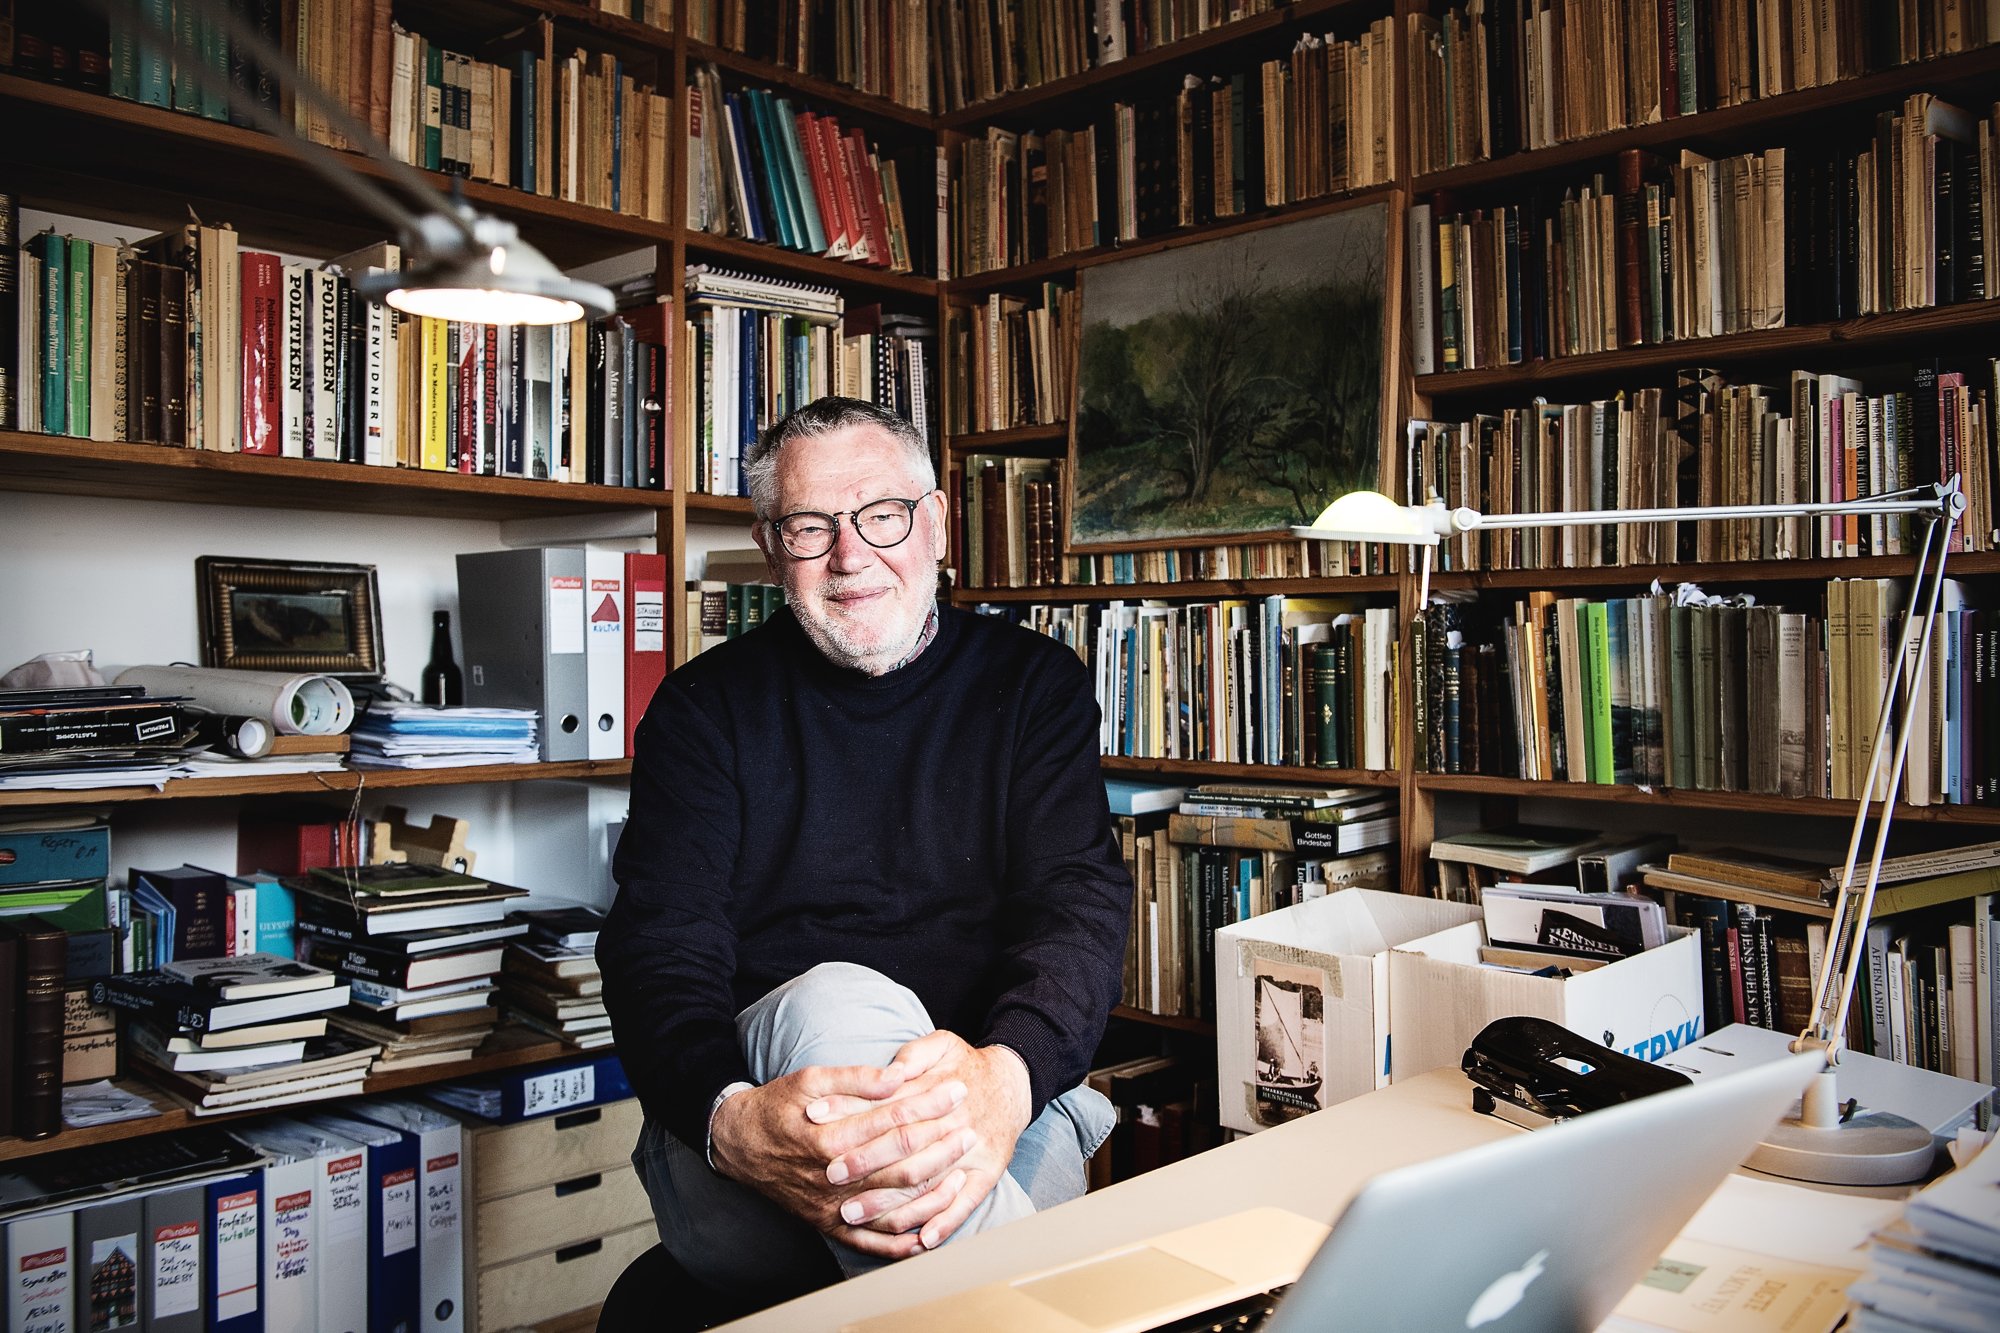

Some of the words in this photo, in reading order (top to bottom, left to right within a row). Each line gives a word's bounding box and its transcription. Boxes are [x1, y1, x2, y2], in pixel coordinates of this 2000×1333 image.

[290, 273, 302, 394] POLITIKEN
[323, 277, 336, 395] POLITIKEN
[431, 379, 439, 409] Modern
[462, 406, 470, 437] OUTSIDER
[1857, 401, 1866, 426] HANS
[1872, 403, 1882, 424] HANS
[1887, 399, 1895, 421] HANS
[1898, 397, 1908, 426] HANS
[430, 411, 438, 442] Century
[1857, 427, 1866, 448] KIRK
[1872, 425, 1882, 443] KIRK
[1887, 422, 1895, 442] KIRK
[1800, 438, 1808, 462] HANS
[1898, 427, 1908, 452] KIRK
[1800, 463, 1808, 482] KIRK
[1415, 634, 1423, 665] Heinrich
[1976, 633, 1984, 683] Fredericiabogen
[1989, 630, 1997, 678] Fredericiabogen
[56, 731, 97, 741] PLASTLOMME
[141, 722, 170, 735] PREMIUM
[1989, 777, 1997, 793] 2016
[1297, 838, 1332, 848] Bindesbøll
[1304, 831, 1332, 841] Gottlieb
[1221, 865, 1230, 896] Maleren
[1549, 926, 1620, 954] HENNER
[1740, 933, 1754, 964] JENS
[1743, 966, 1758, 1004] JUELS
[1872, 946, 1885, 1027] AFTENLANDET
[1622, 1015, 1701, 1063] TRYK
[1262, 1091, 1290, 1104] HENNER
[386, 1219, 413, 1234] Musik
